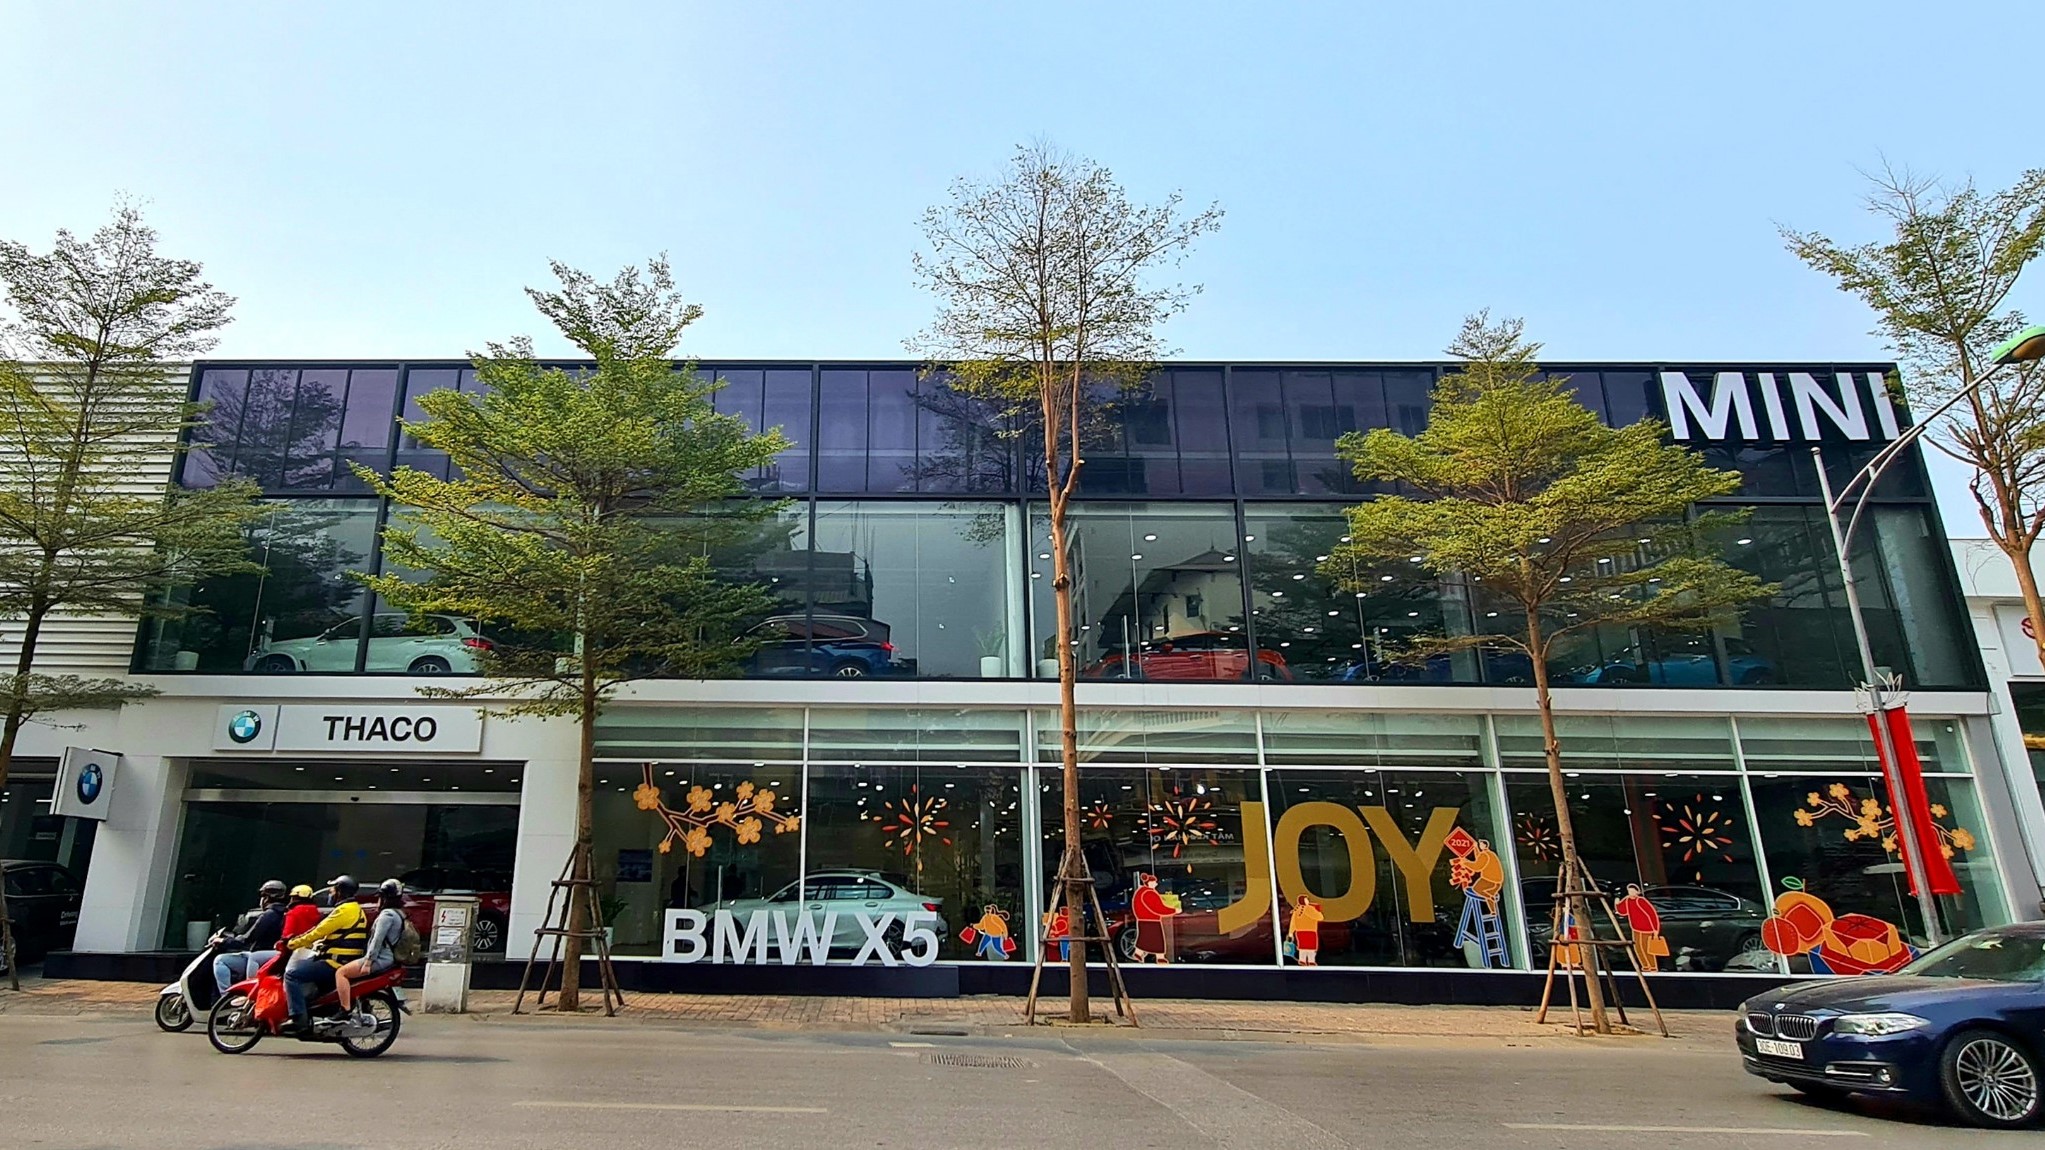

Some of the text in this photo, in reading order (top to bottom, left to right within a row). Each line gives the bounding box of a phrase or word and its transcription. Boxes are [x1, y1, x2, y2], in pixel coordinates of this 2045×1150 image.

[1660, 372, 1900, 441] MINI
[322, 716, 437, 742] THACO
[1217, 801, 1460, 935] JOY
[1451, 839, 1470, 847] 2021
[662, 908, 939, 968] BMW X5
